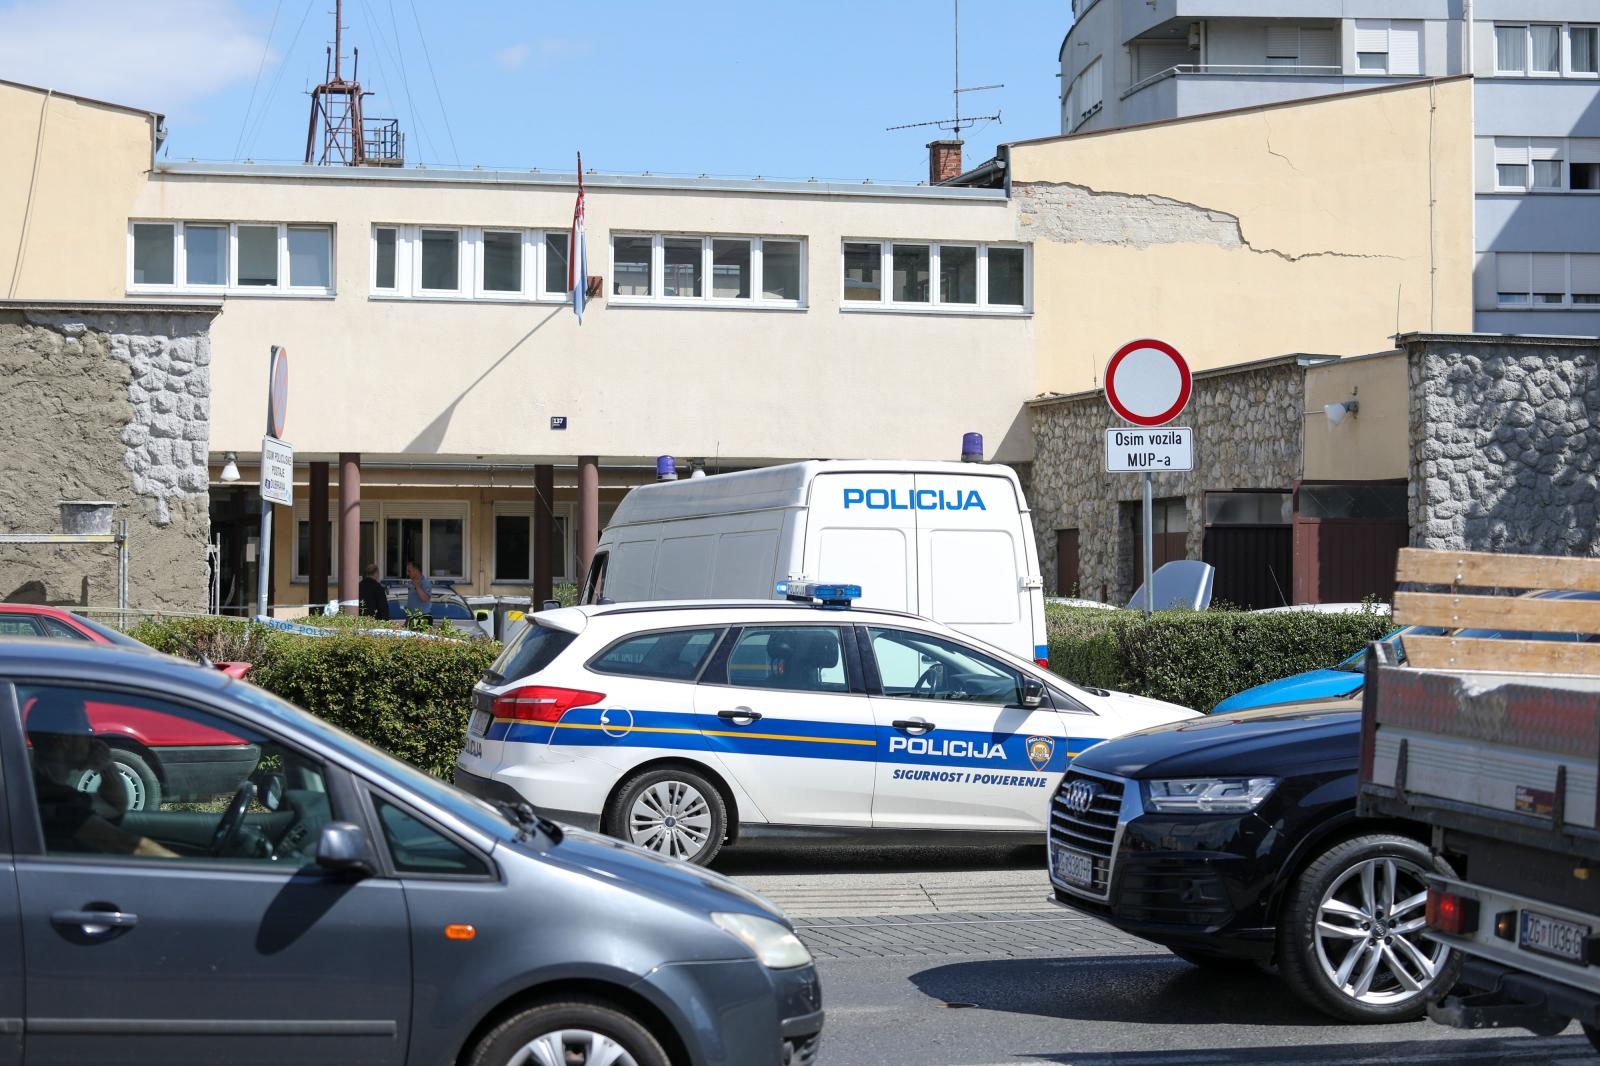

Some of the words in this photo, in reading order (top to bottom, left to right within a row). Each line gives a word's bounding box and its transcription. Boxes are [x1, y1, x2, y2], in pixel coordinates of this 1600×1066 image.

[1115, 432, 1144, 446] Osim
[1149, 431, 1182, 445] vozila
[1127, 453, 1171, 467] MUP-a
[843, 488, 987, 511] POLICIJA
[268, 620, 294, 632] STOP
[889, 736, 1007, 760] POLICIJA
[893, 769, 963, 783] SIGURNOST
[965, 773, 970, 783] I
[973, 774, 1047, 788] POVJERENJE
